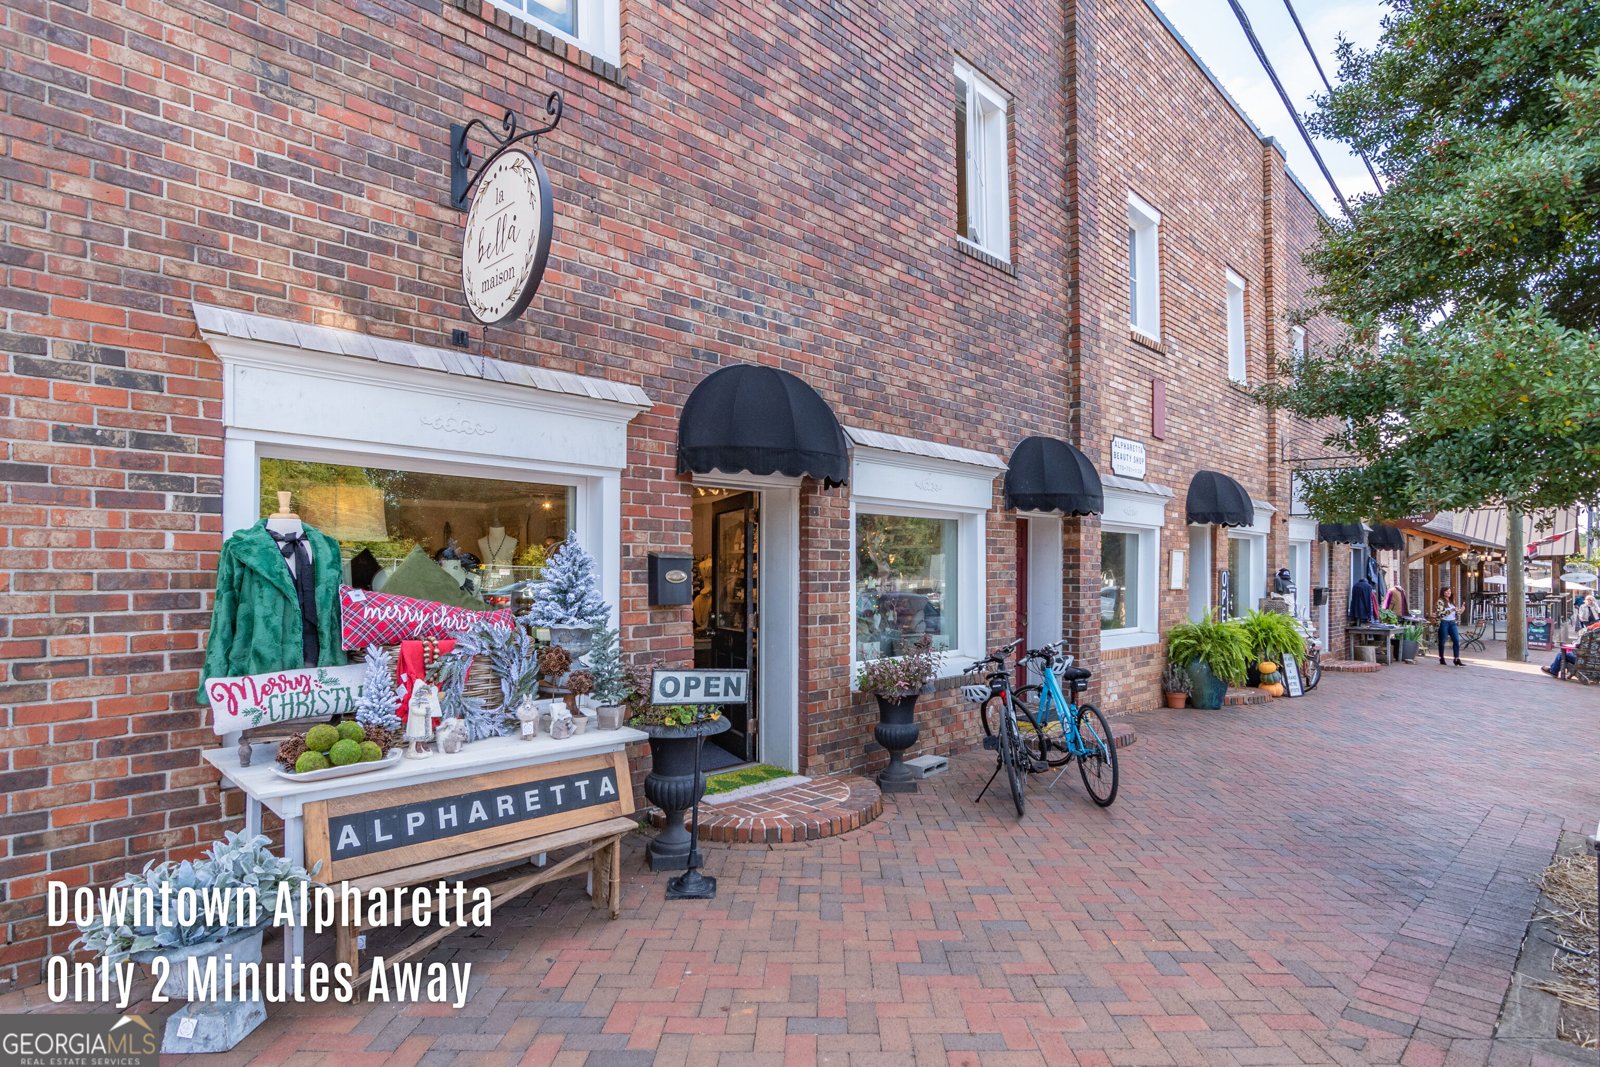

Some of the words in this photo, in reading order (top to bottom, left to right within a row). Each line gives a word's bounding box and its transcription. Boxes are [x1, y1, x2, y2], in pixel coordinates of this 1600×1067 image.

[495, 187, 505, 206] la
[477, 213, 521, 264] bella
[480, 266, 516, 294] maison
[1114, 440, 1143, 454] ALPHARETTA
[1114, 451, 1131, 462] BEAUTY
[363, 605, 430, 636] merry
[210, 674, 312, 716] Merry
[658, 676, 742, 698] OPEN
[336, 776, 616, 851] ALPHARETTA
